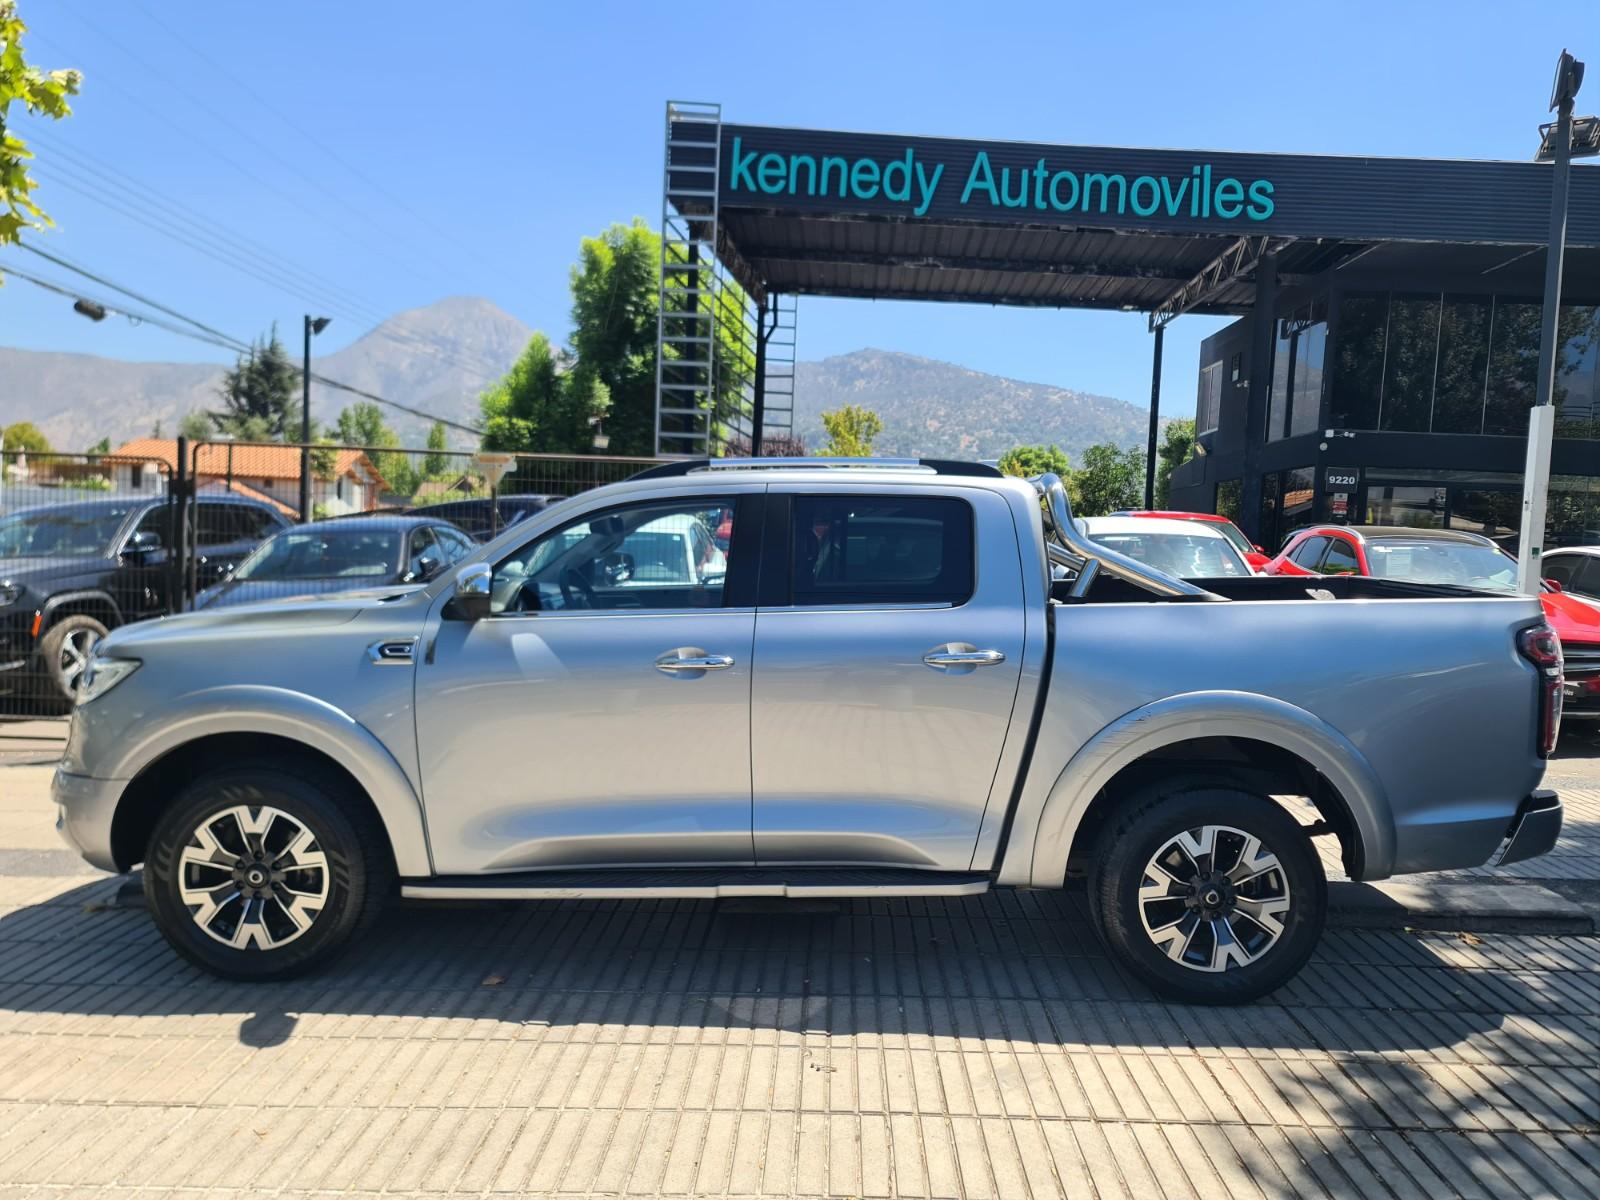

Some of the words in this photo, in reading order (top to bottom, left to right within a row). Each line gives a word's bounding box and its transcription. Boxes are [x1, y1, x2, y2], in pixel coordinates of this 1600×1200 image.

[730, 136, 944, 216] kennedy
[960, 151, 1275, 221] Automoviles
[1329, 476, 1355, 484] 9220
